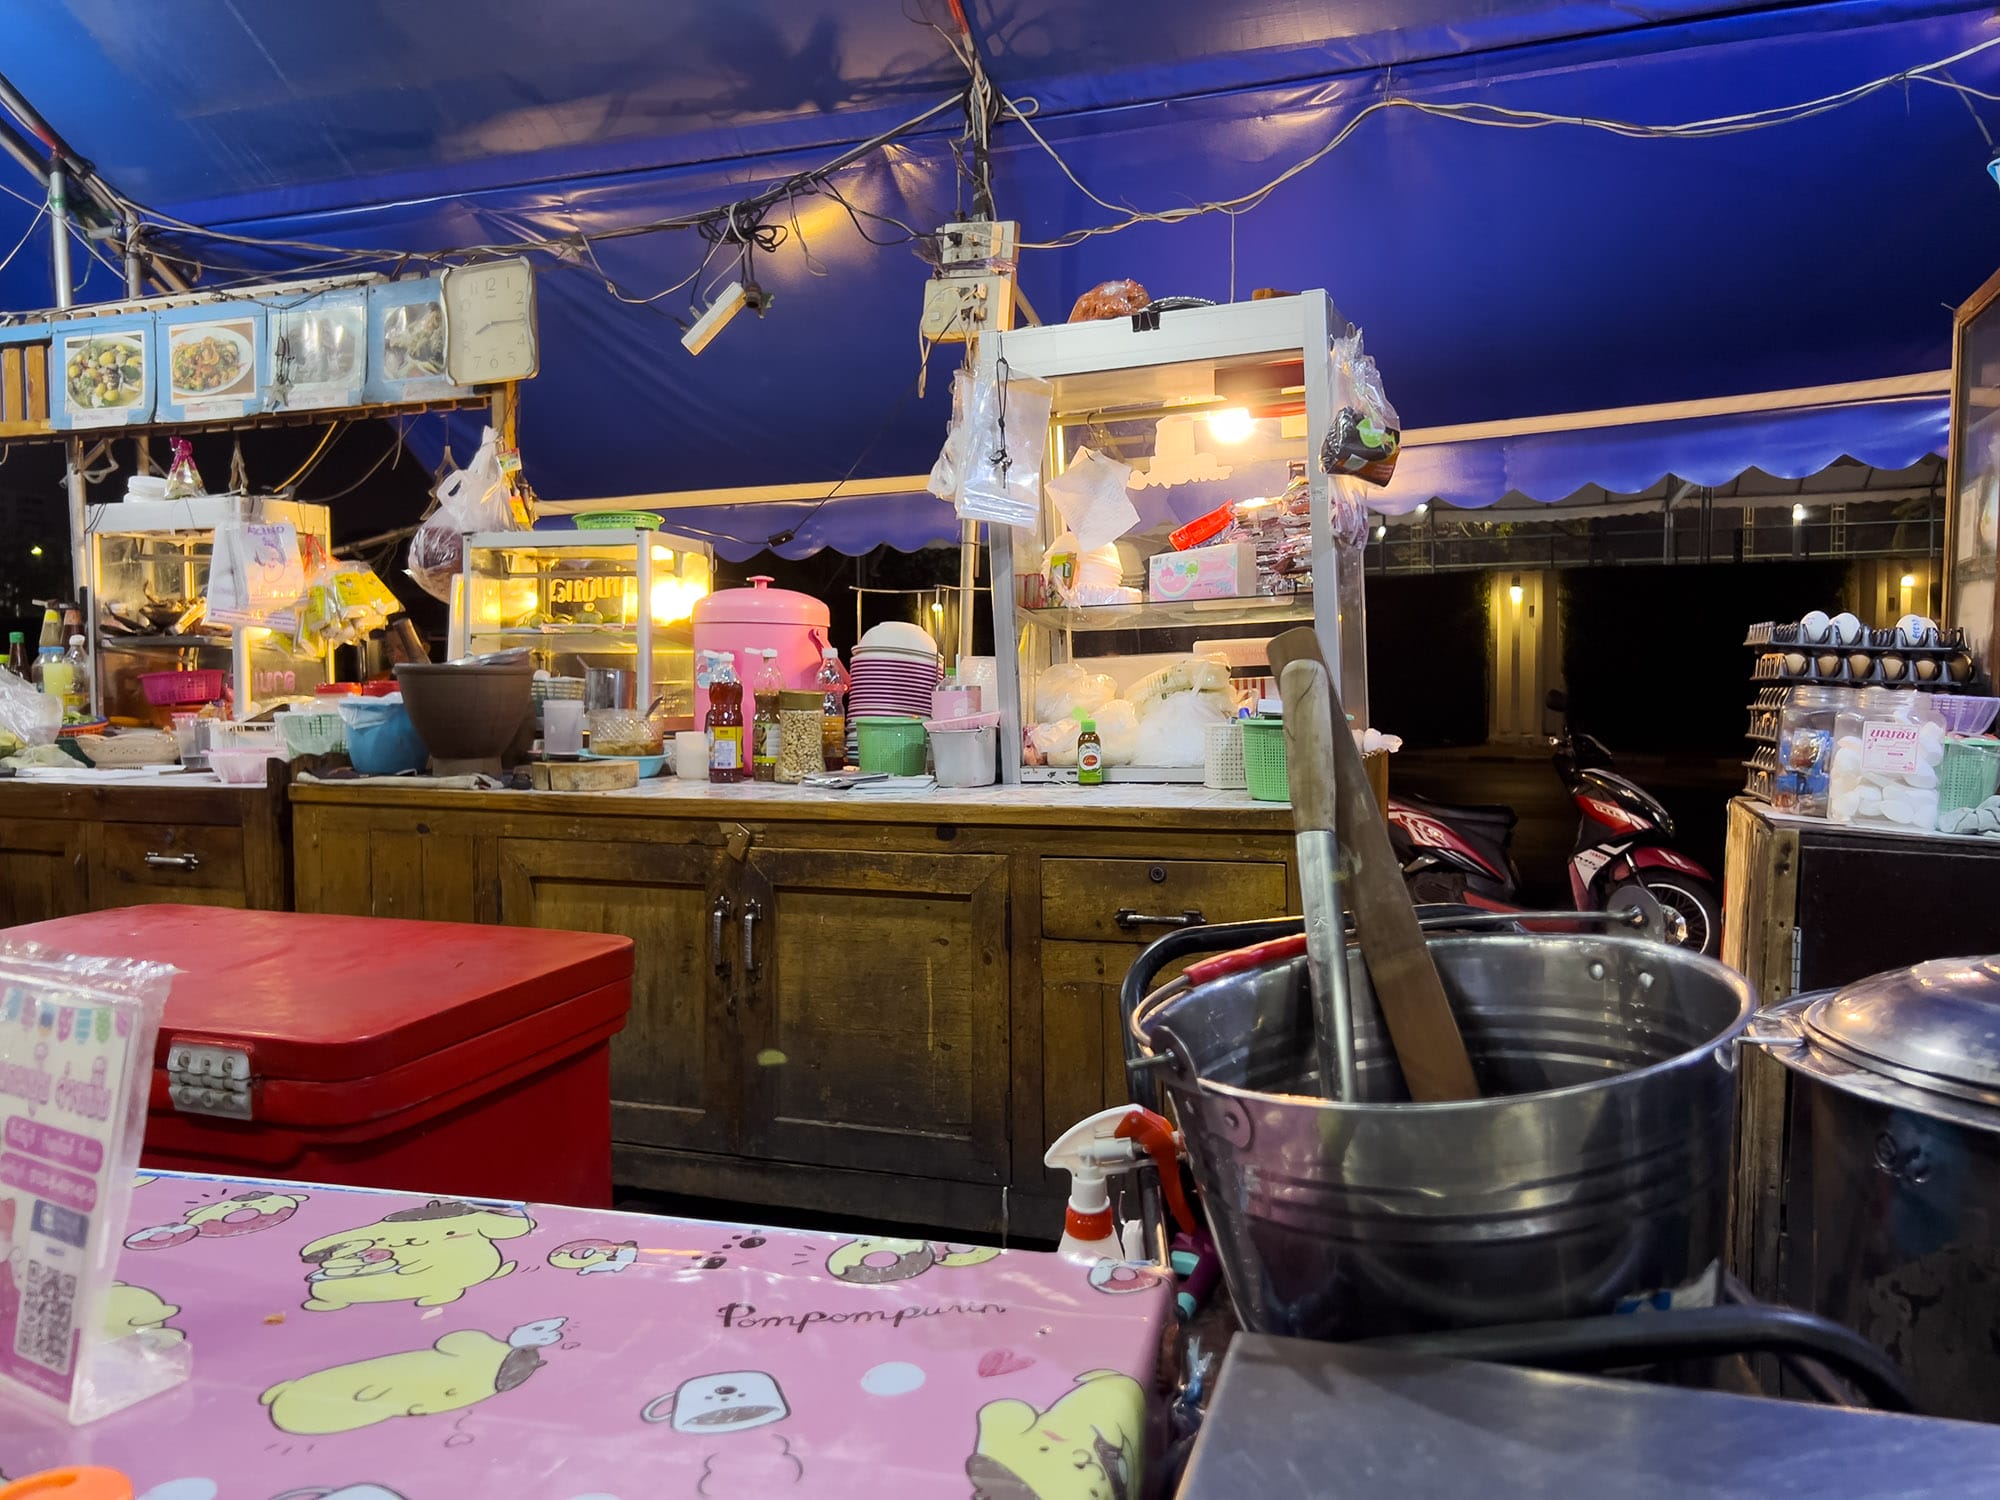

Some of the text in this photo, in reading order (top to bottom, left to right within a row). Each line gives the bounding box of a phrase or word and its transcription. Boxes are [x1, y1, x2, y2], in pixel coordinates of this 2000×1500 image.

[485, 277, 496, 291] 12
[516, 291, 524, 304] 2
[517, 333, 525, 345] 4
[473, 356, 481, 369] 7
[489, 355, 499, 368] 6
[507, 352, 516, 365] 5
[717, 1302, 1006, 1333] Pompompurin
